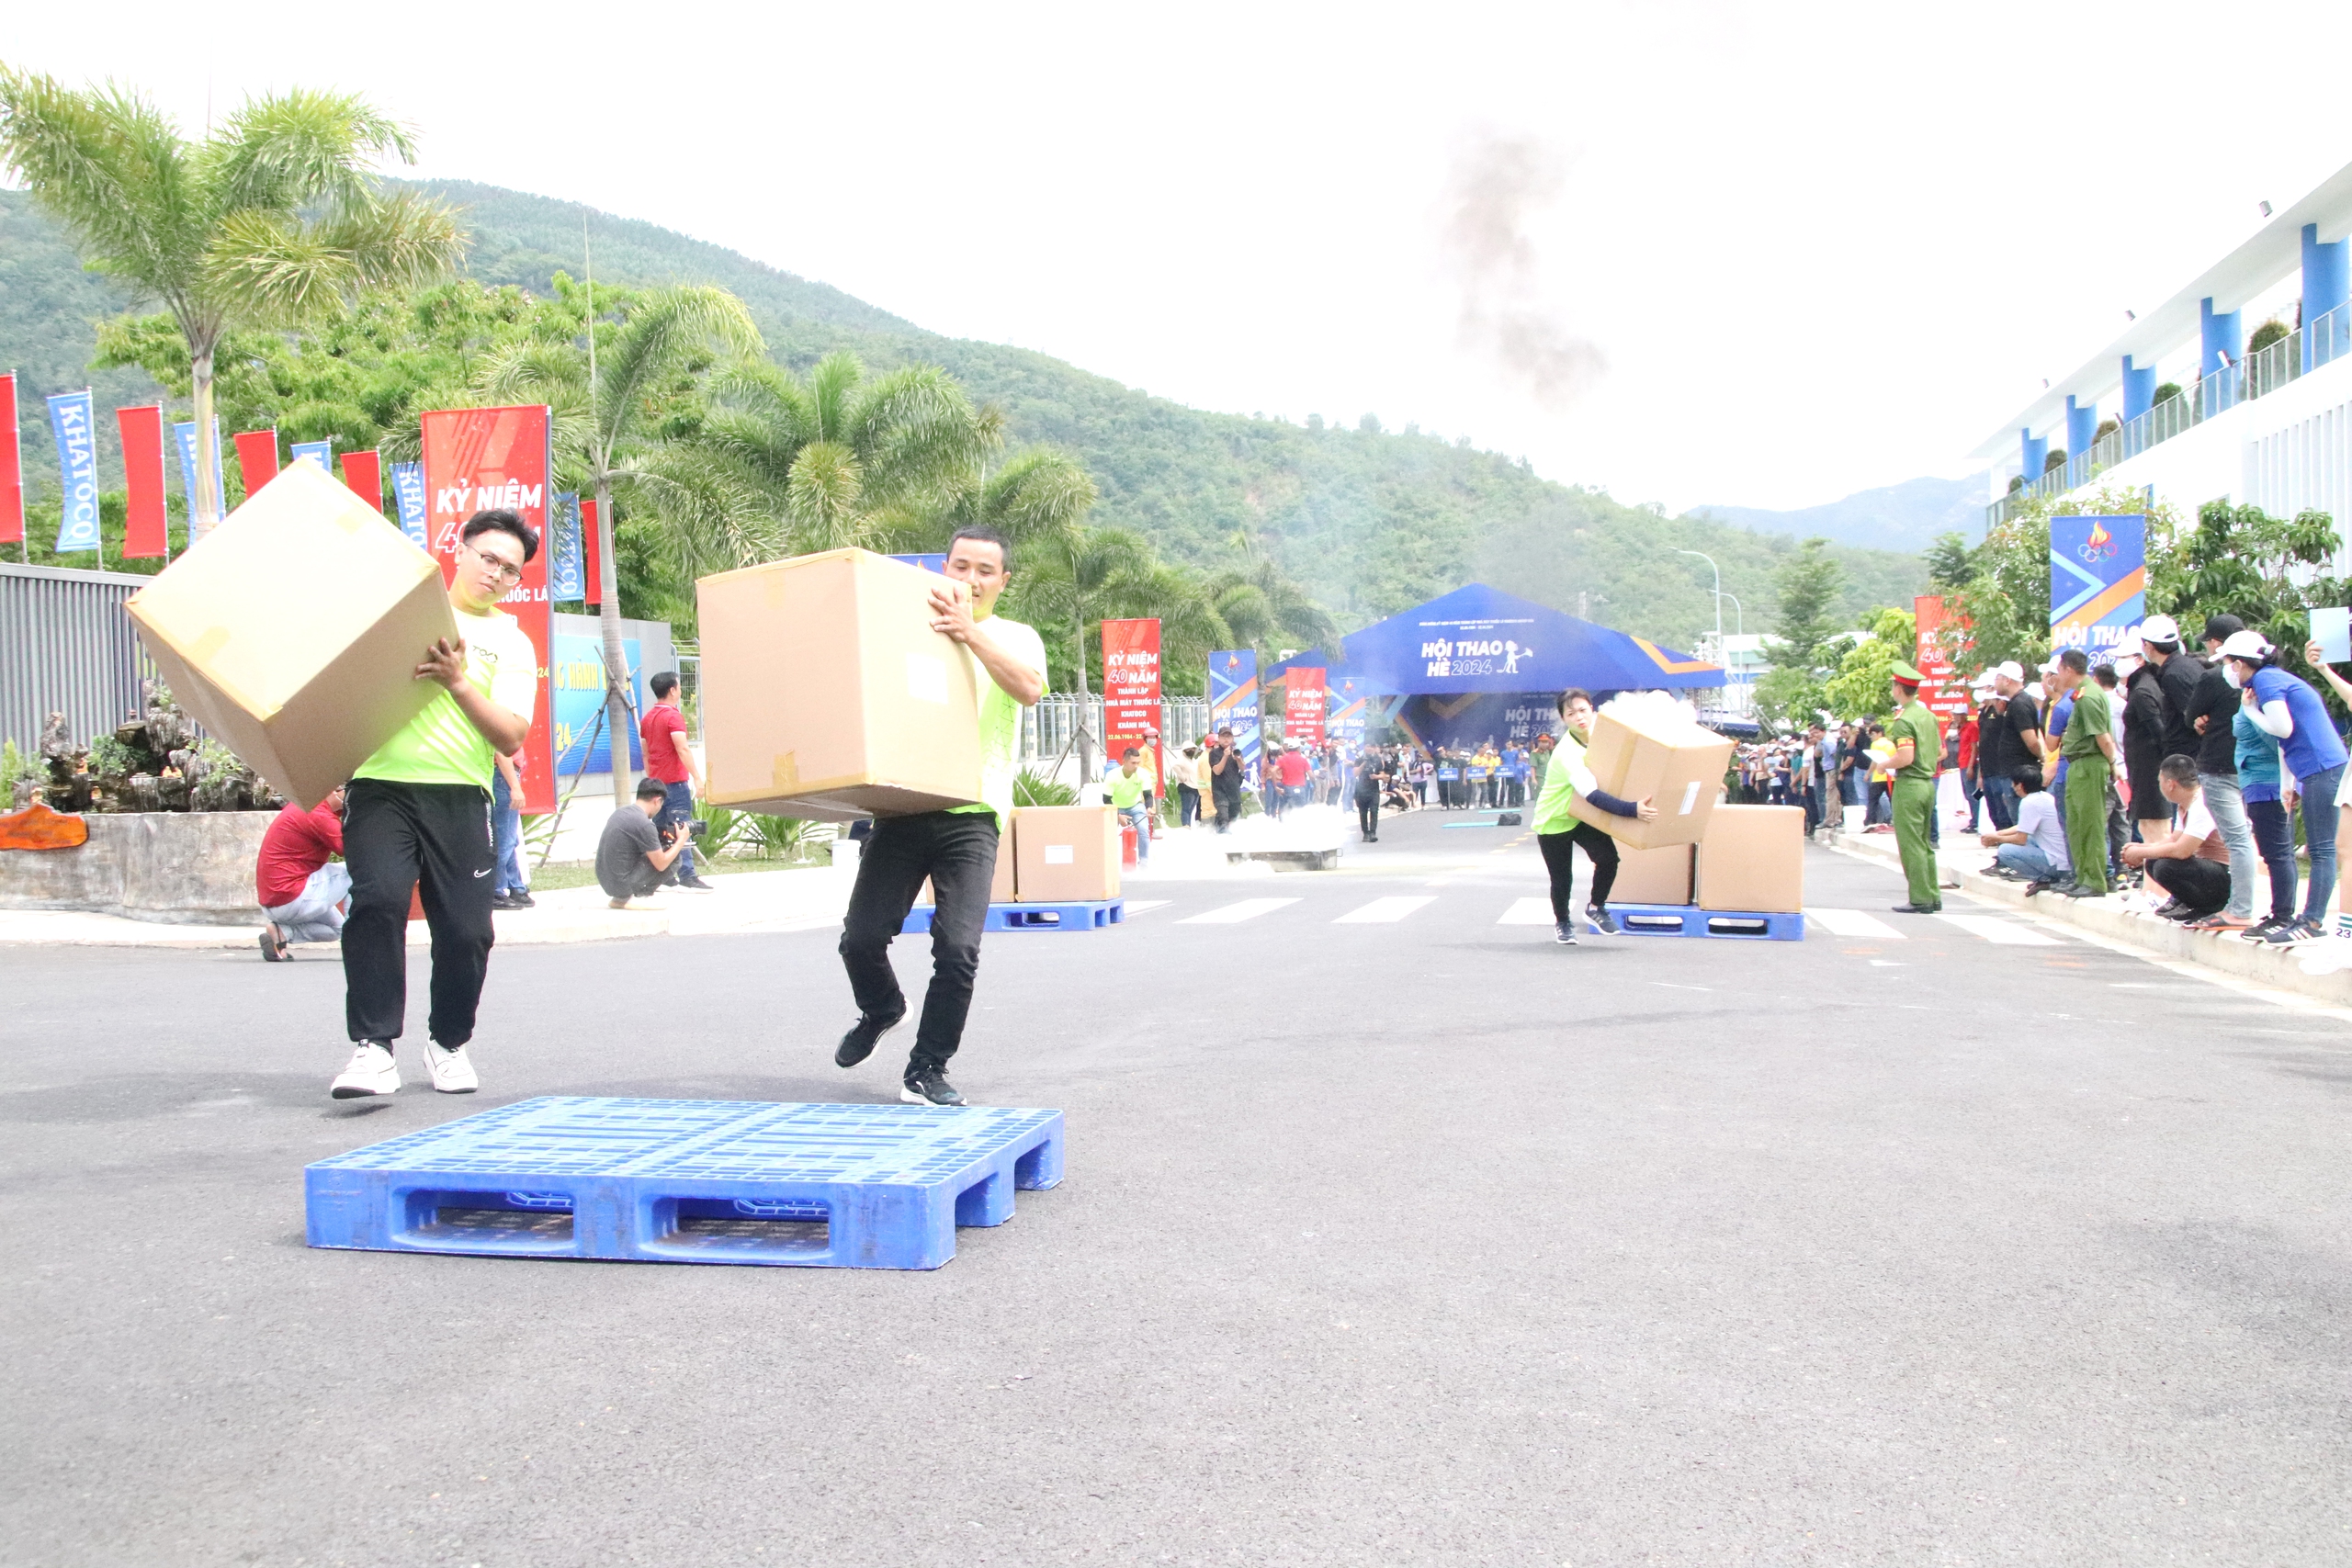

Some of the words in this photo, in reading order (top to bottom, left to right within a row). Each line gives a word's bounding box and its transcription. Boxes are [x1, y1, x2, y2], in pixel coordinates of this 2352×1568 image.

[59, 404, 94, 539] KHATOCO
[436, 478, 471, 513] KỶ
[399, 470, 426, 547] KHATO
[497, 584, 531, 603] UỐC
[534, 585, 548, 602] LÁ
[2053, 621, 2088, 649] HỘI
[1421, 637, 1453, 661] HỘI
[1456, 640, 1503, 656] THAO
[1920, 648, 1943, 662] 40
[1108, 650, 1125, 666] KỶ
[1127, 650, 1158, 668] NIỆM
[1427, 658, 1451, 676] HÈ
[1452, 659, 1493, 676] 2024
[568, 654, 599, 691] HÀNH
[1107, 669, 1127, 683] 40
[1128, 669, 1157, 683] NĂM
[1117, 687, 1136, 695] THÀNH
[1137, 687, 1149, 696] LẬP
[1289, 688, 1300, 698] KỶ
[1302, 688, 1323, 700] NIỆM
[1120, 698, 1132, 706] MÁY
[1133, 697, 1153, 706] THUỐC
[1303, 700, 1322, 710] NĂM
[1215, 705, 1230, 720] HỘI
[1233, 706, 1258, 717] THAO
[1505, 705, 1532, 725] HỘI
[1346, 718, 1364, 727] THAO
[1510, 721, 1530, 739] HÈ
[2335, 928, 2351, 938] 23
